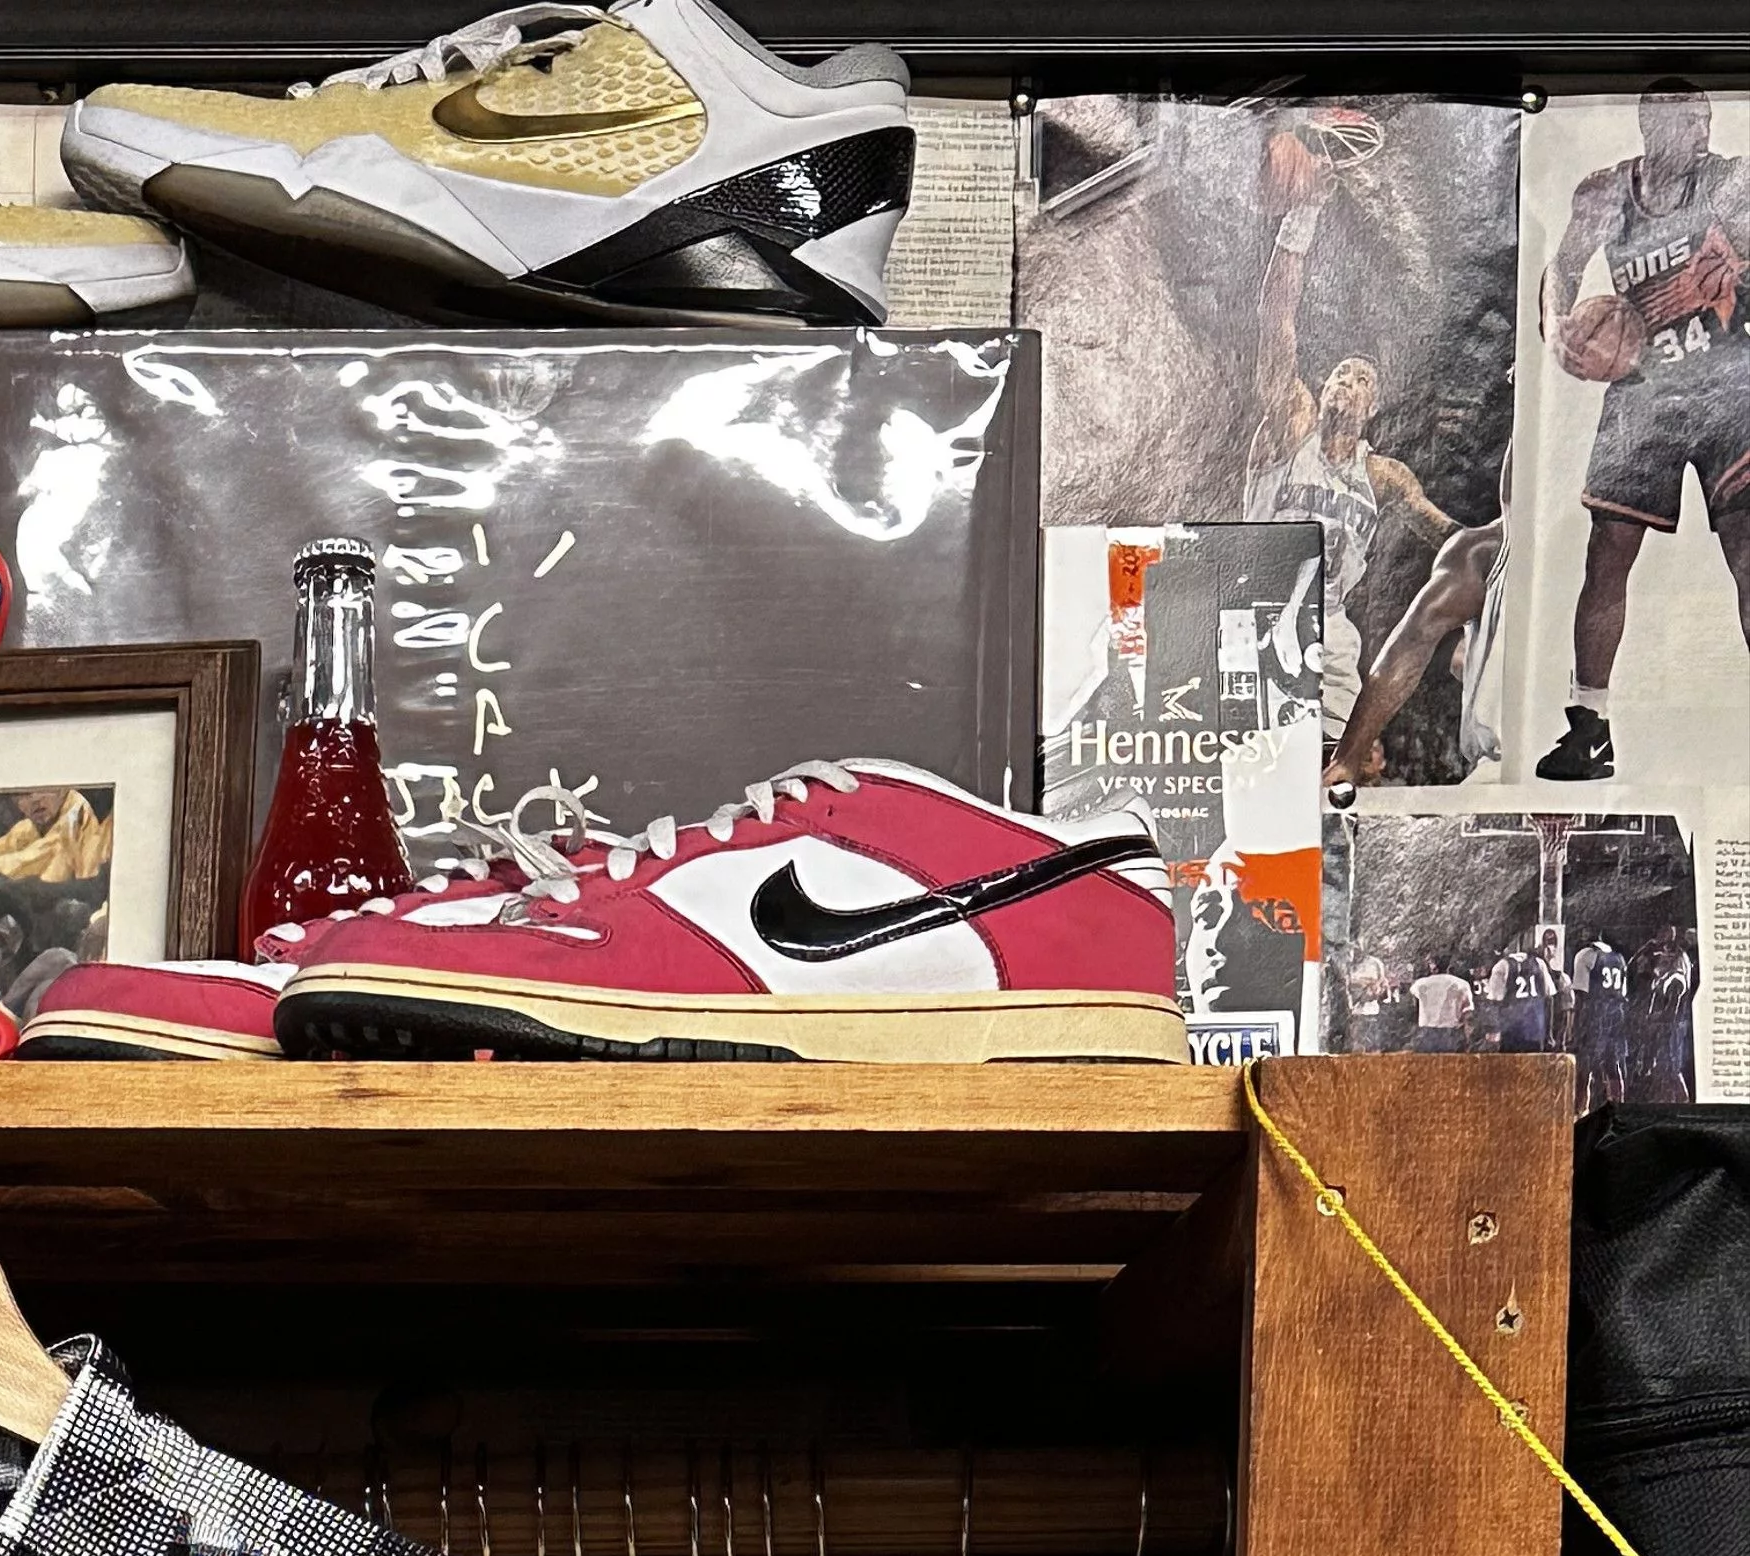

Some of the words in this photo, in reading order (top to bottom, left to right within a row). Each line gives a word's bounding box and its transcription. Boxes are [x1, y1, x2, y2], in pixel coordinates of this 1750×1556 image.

[1653, 316, 1711, 364] 34
[1070, 719, 1287, 774] Hennessy
[1164, 776, 1235, 795] SPEC
[1514, 974, 1538, 999] 21
[1187, 1030, 1276, 1067] YCLE
